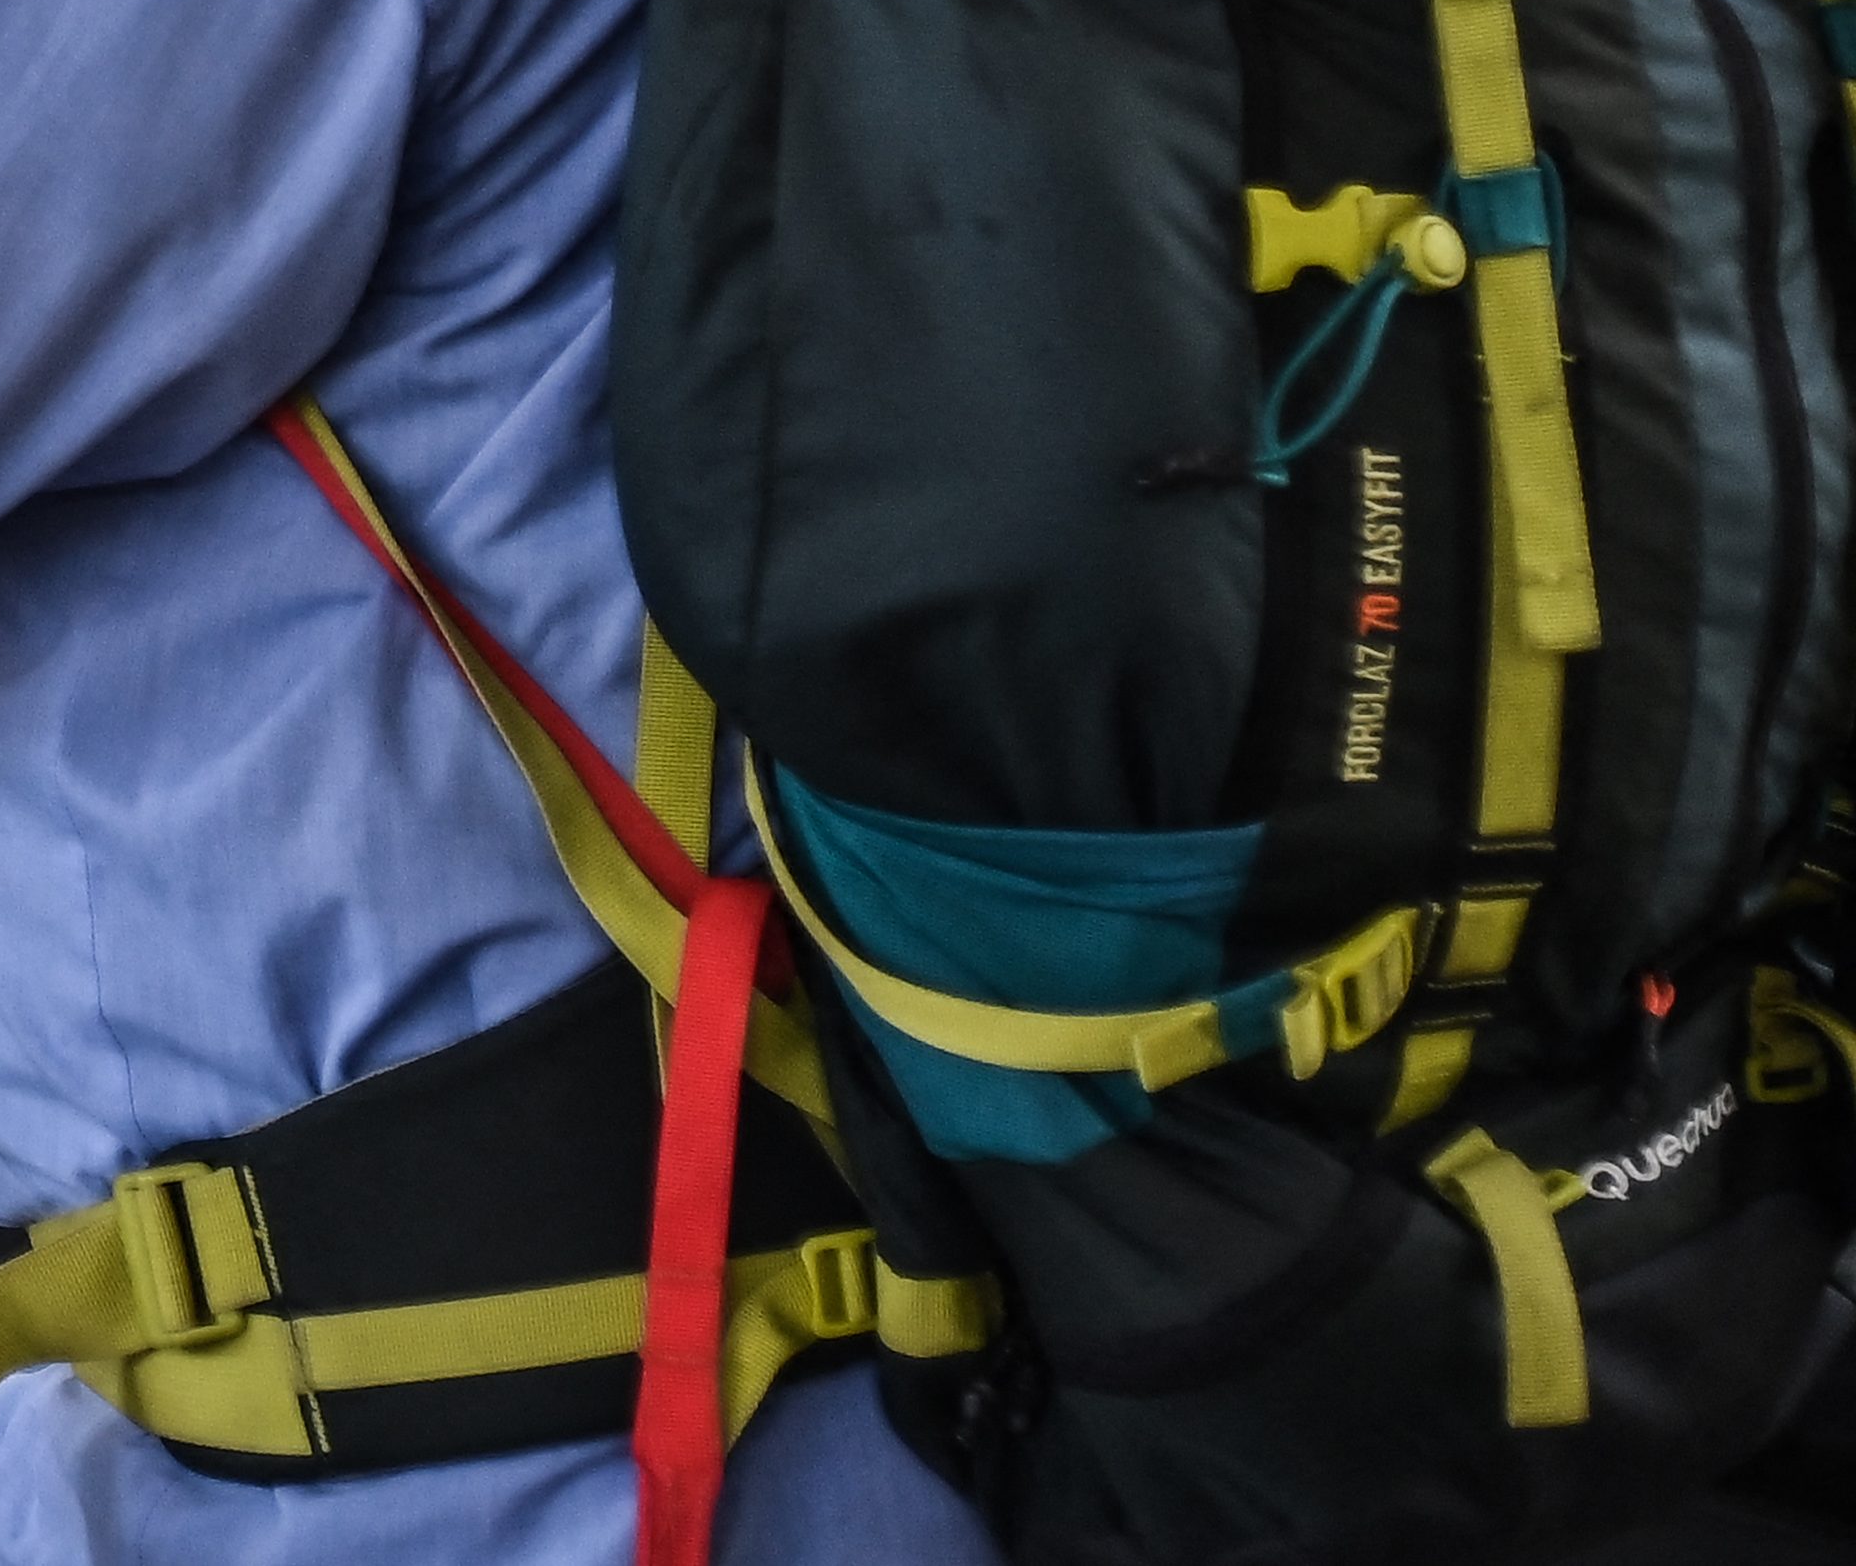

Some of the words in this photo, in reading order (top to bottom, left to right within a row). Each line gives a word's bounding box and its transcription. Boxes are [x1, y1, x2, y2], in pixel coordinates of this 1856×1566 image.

[1361, 447, 1404, 585] EASYFIT
[1359, 593, 1401, 636] 70
[1342, 643, 1396, 782] FORCLAZ
